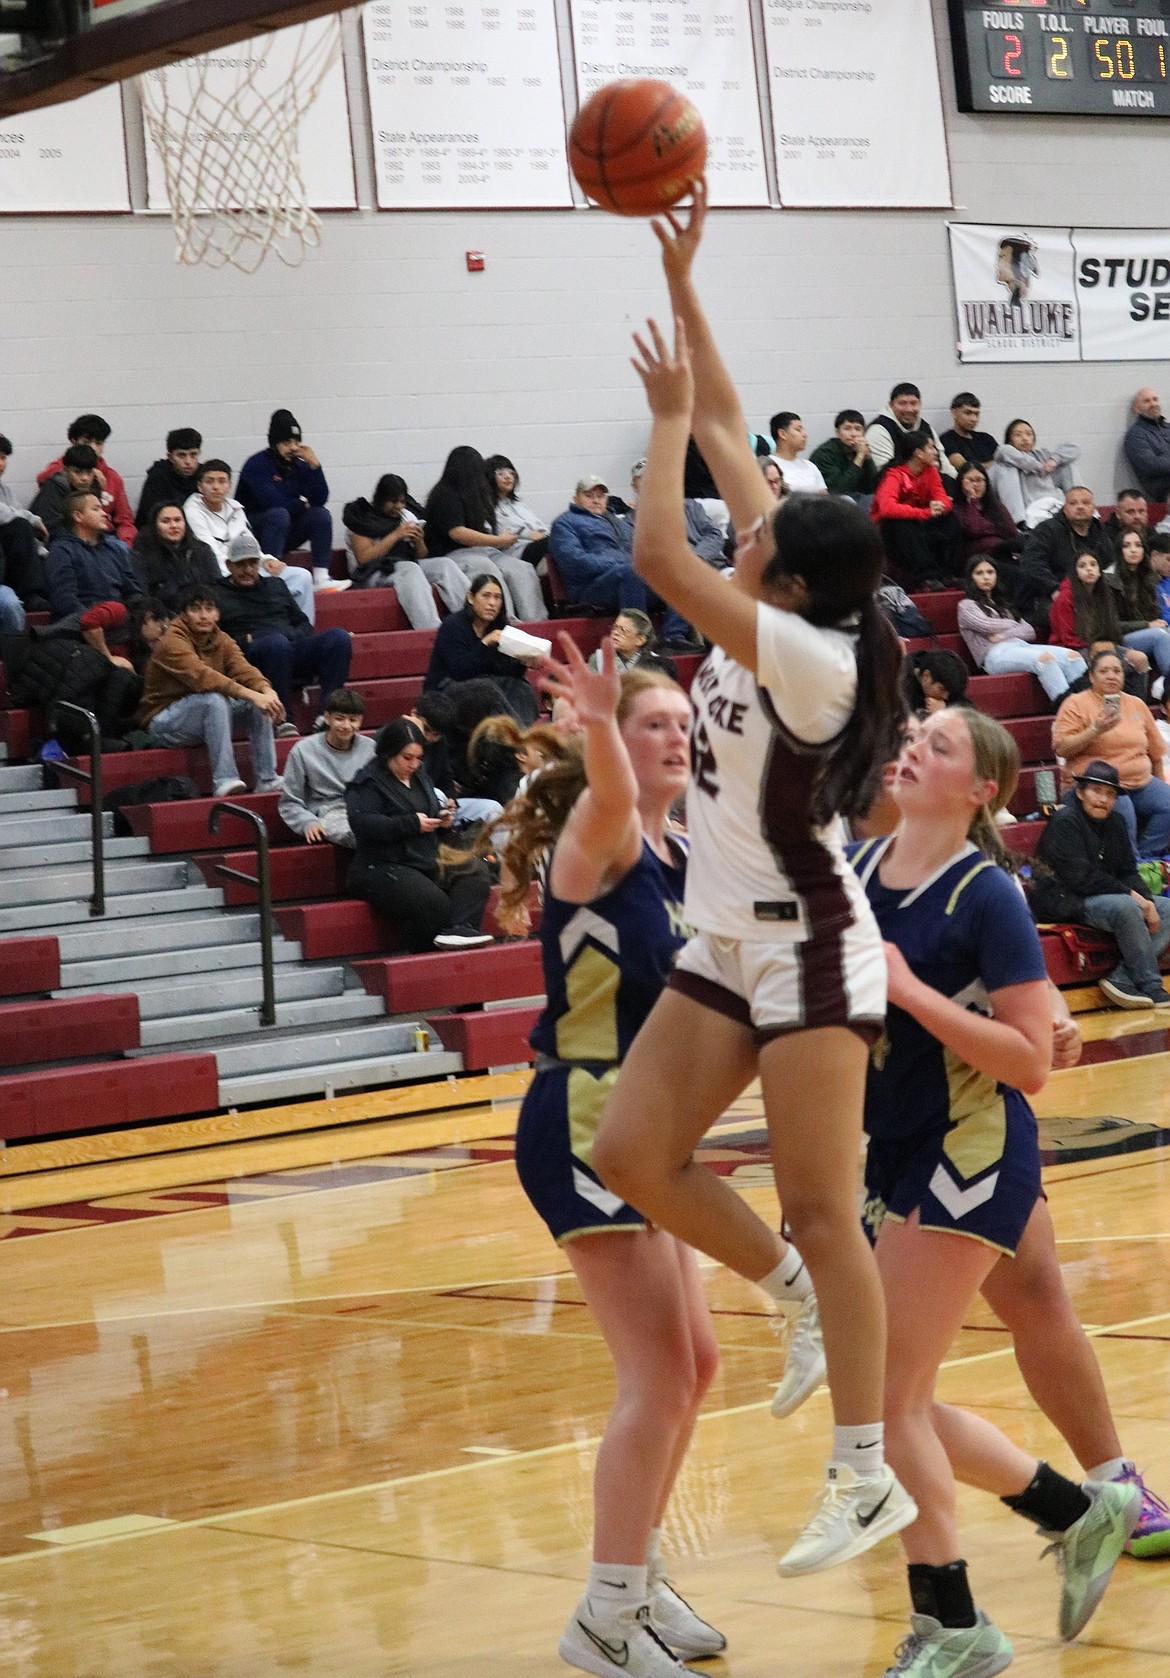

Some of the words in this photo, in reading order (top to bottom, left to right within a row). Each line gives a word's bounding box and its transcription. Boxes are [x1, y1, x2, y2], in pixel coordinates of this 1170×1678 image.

[982, 11, 1024, 30] FOULS
[1038, 14, 1074, 32] T.O.L.
[1084, 16, 1130, 35] PLAYER
[1137, 18, 1168, 37] FOUL
[371, 58, 409, 71] District
[411, 59, 488, 74] Championship
[1004, 34, 1021, 76] 2
[1051, 37, 1068, 77] 2
[1095, 39, 1135, 79] 50
[1158, 45, 1166, 78] 1
[580, 62, 615, 74] District
[618, 63, 689, 77] Championship
[774, 66, 808, 79] District
[809, 67, 876, 83] Championship
[989, 85, 1032, 104] SCORE
[1112, 89, 1155, 108] MATCH
[378, 130, 406, 143] State
[409, 131, 479, 145] Appearances
[780, 134, 805, 147] State
[807, 135, 871, 148] Appearances
[1079, 258, 1170, 288] STUD
[1130, 292, 1170, 321] SE
[964, 302, 1075, 340] WAHLUKE
